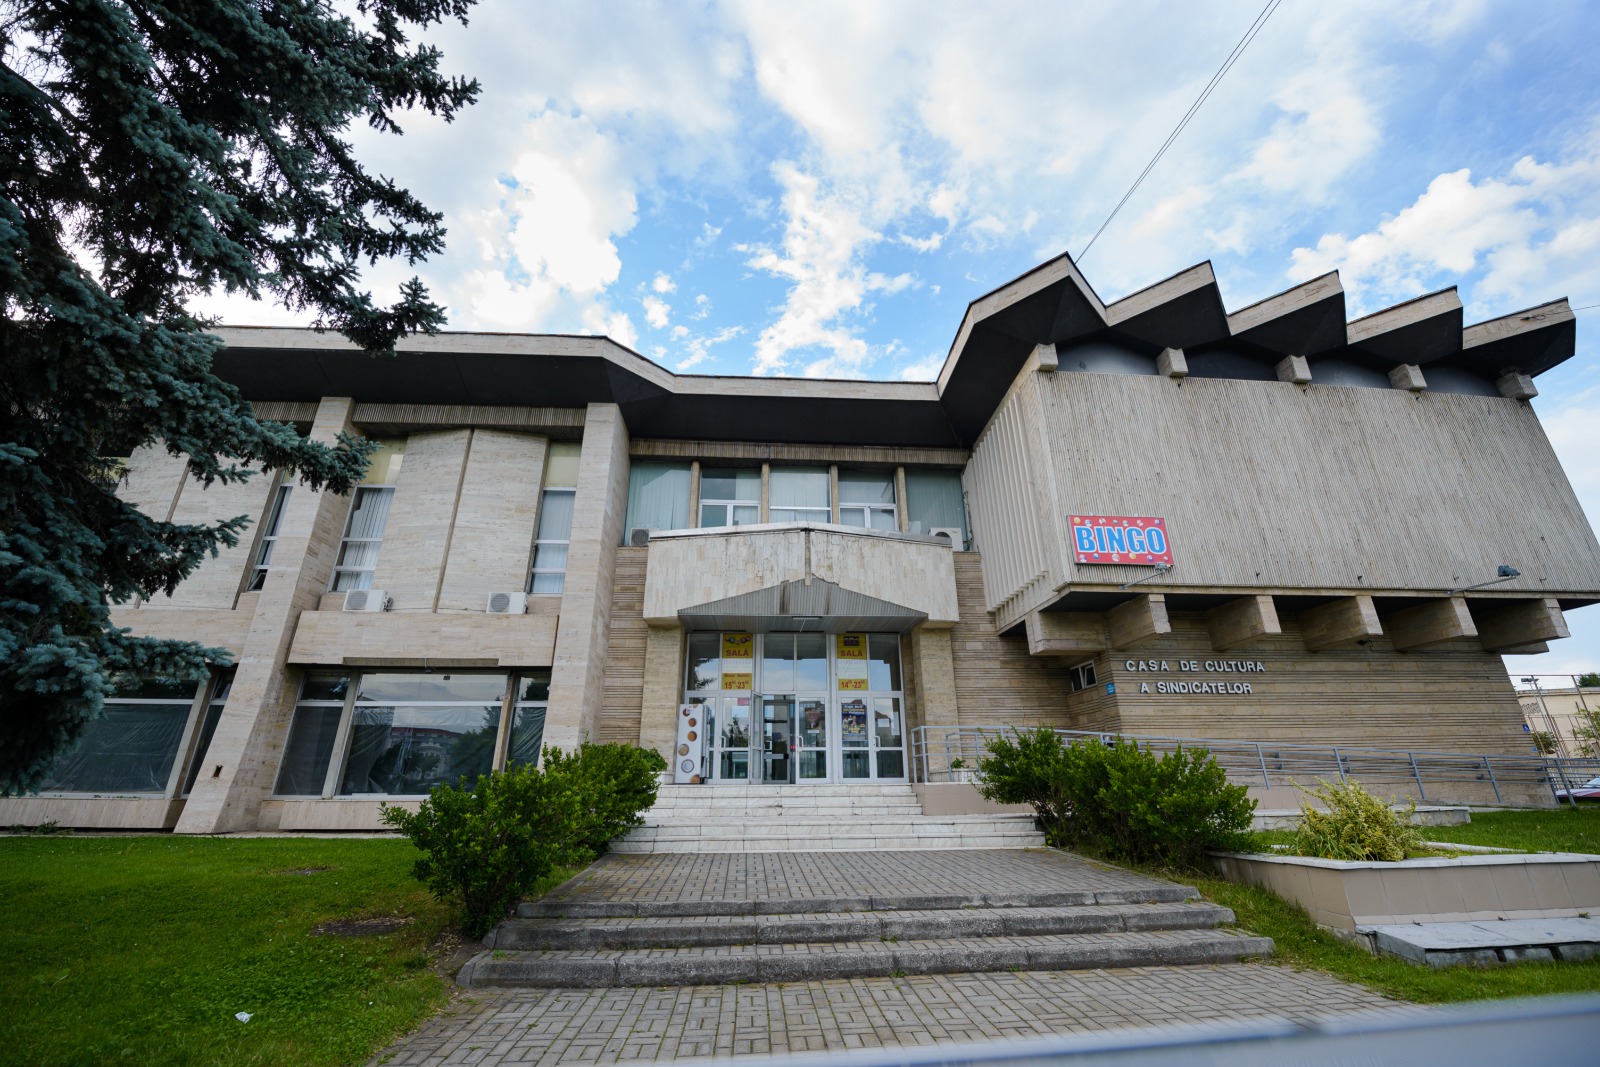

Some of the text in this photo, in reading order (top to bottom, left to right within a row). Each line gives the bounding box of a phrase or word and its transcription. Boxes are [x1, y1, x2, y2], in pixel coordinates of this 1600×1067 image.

[1074, 526, 1167, 554] BINGO
[1125, 660, 1265, 673] CASA DE CULTURA
[1140, 681, 1252, 694] A SINDICATELOR
